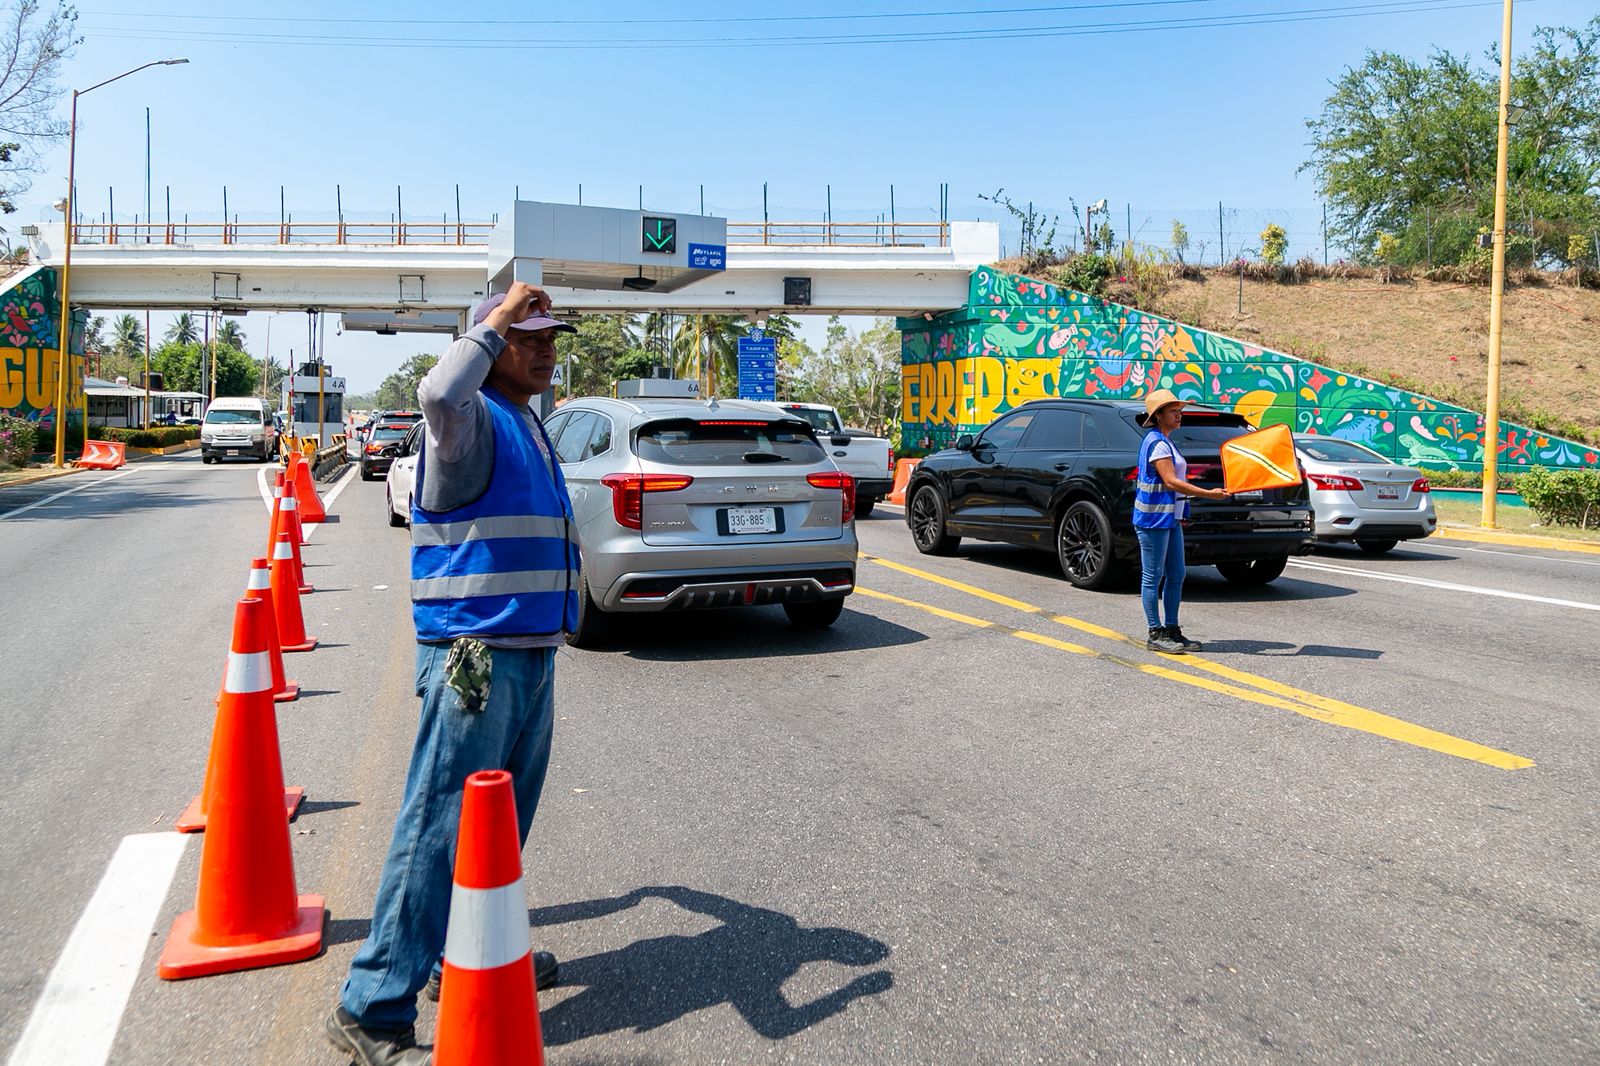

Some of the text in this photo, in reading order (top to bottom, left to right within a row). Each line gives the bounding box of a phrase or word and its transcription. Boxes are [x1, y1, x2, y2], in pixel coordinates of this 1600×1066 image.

[332, 380, 345, 389] 4A
[688, 384, 700, 393] 6A
[730, 514, 764, 526] 33G-885
